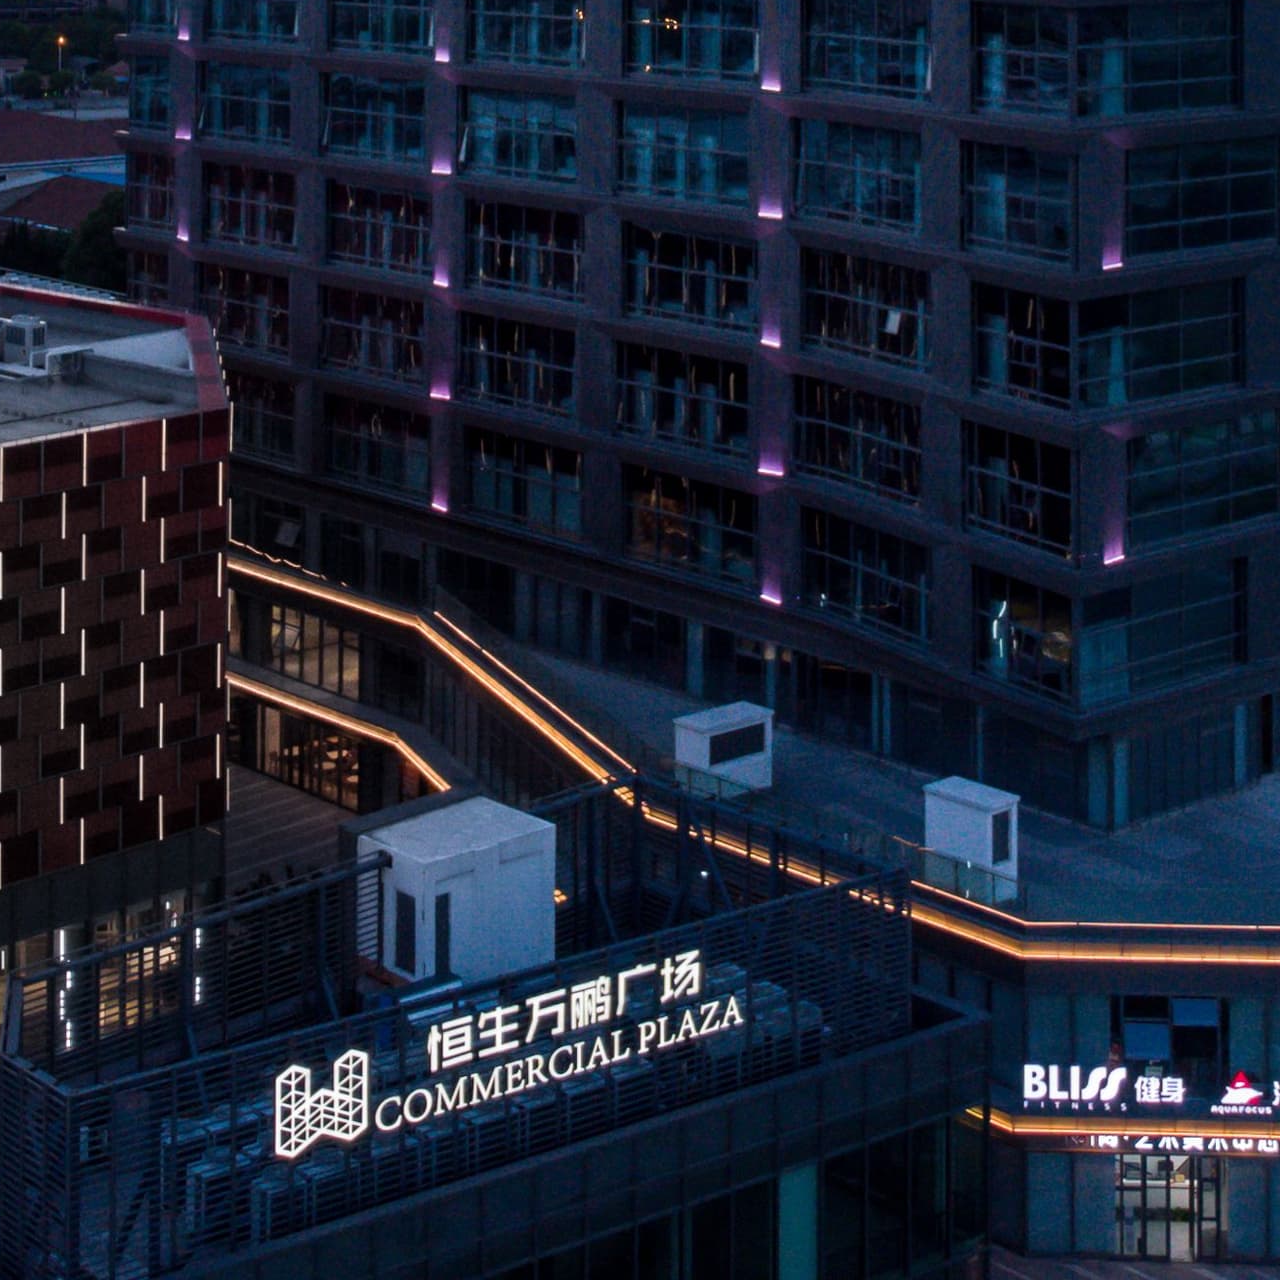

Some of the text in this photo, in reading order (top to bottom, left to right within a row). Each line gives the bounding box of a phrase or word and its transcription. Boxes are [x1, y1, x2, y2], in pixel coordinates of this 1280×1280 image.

[427, 949, 702, 1073] 恒生万鹂广场
[375, 995, 745, 1131] COMMERCIAL PLAZA
[1023, 1063, 1187, 1104] BLISS 健身
[1023, 1100, 1128, 1112] FITNESS
